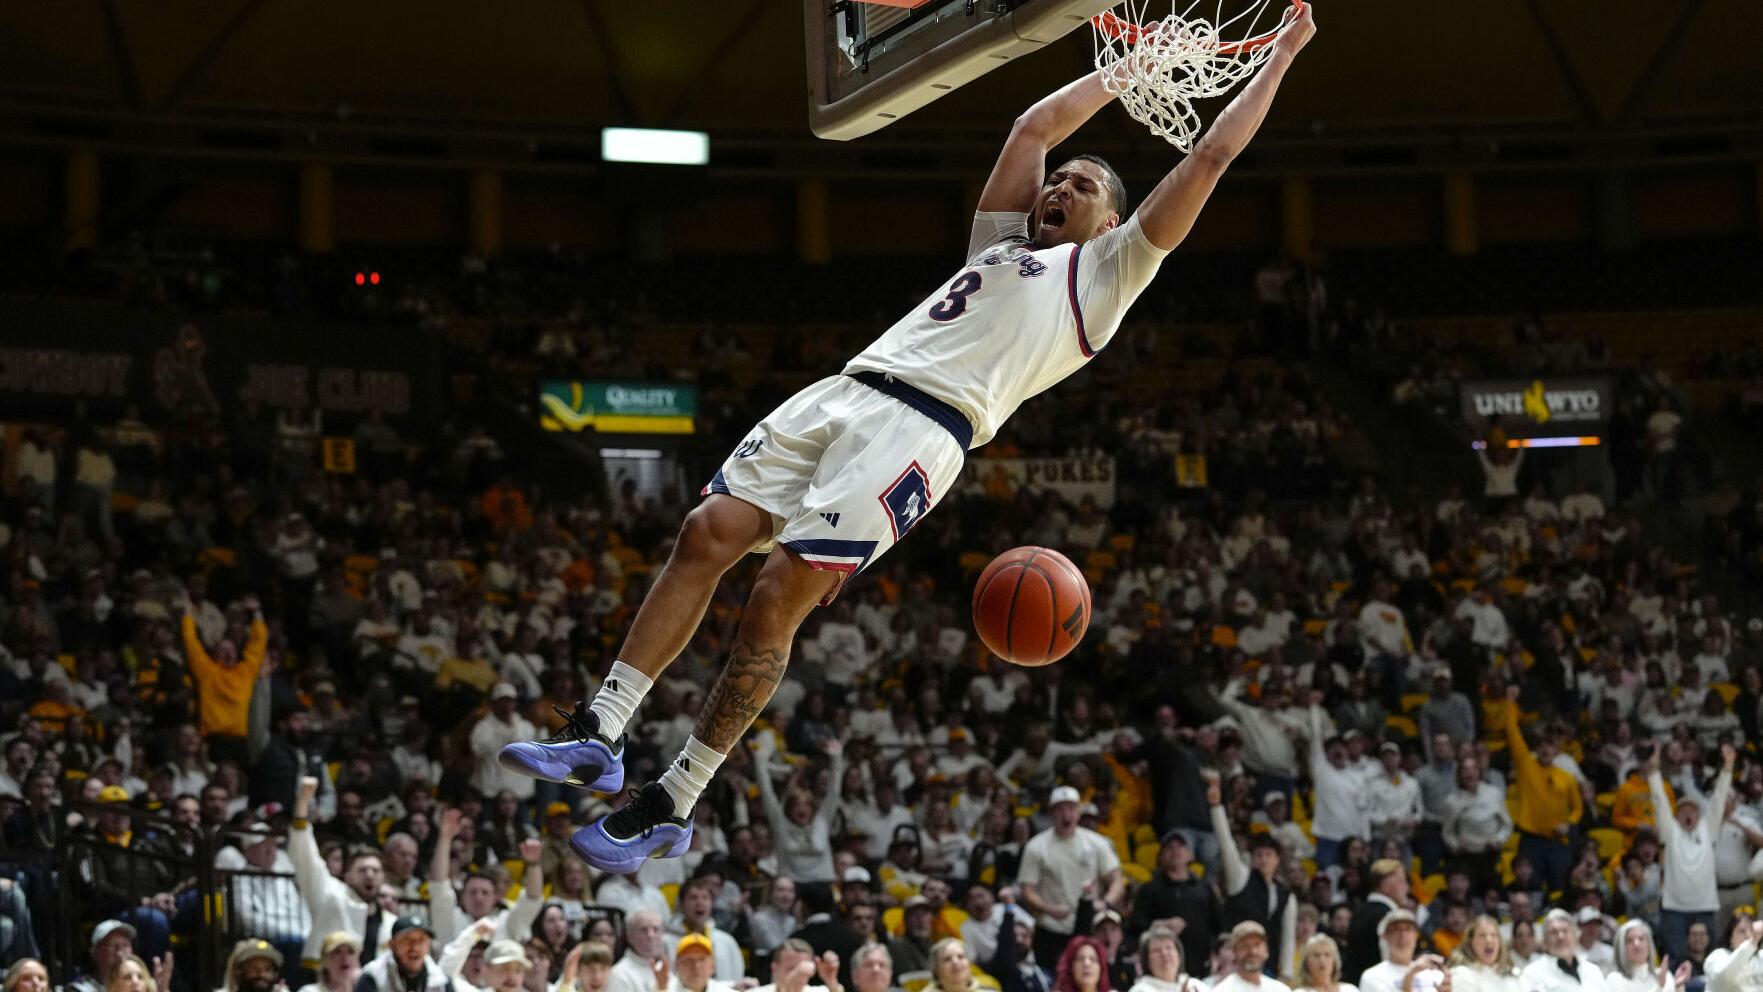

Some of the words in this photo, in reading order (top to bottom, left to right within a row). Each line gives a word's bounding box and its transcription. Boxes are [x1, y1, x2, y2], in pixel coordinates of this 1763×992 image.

[928, 271, 983, 322] 3
[605, 384, 677, 409] QUALITY
[1474, 391, 1524, 416] UNI
[1545, 390, 1600, 413] WYO
[1025, 461, 1112, 483] POKES
